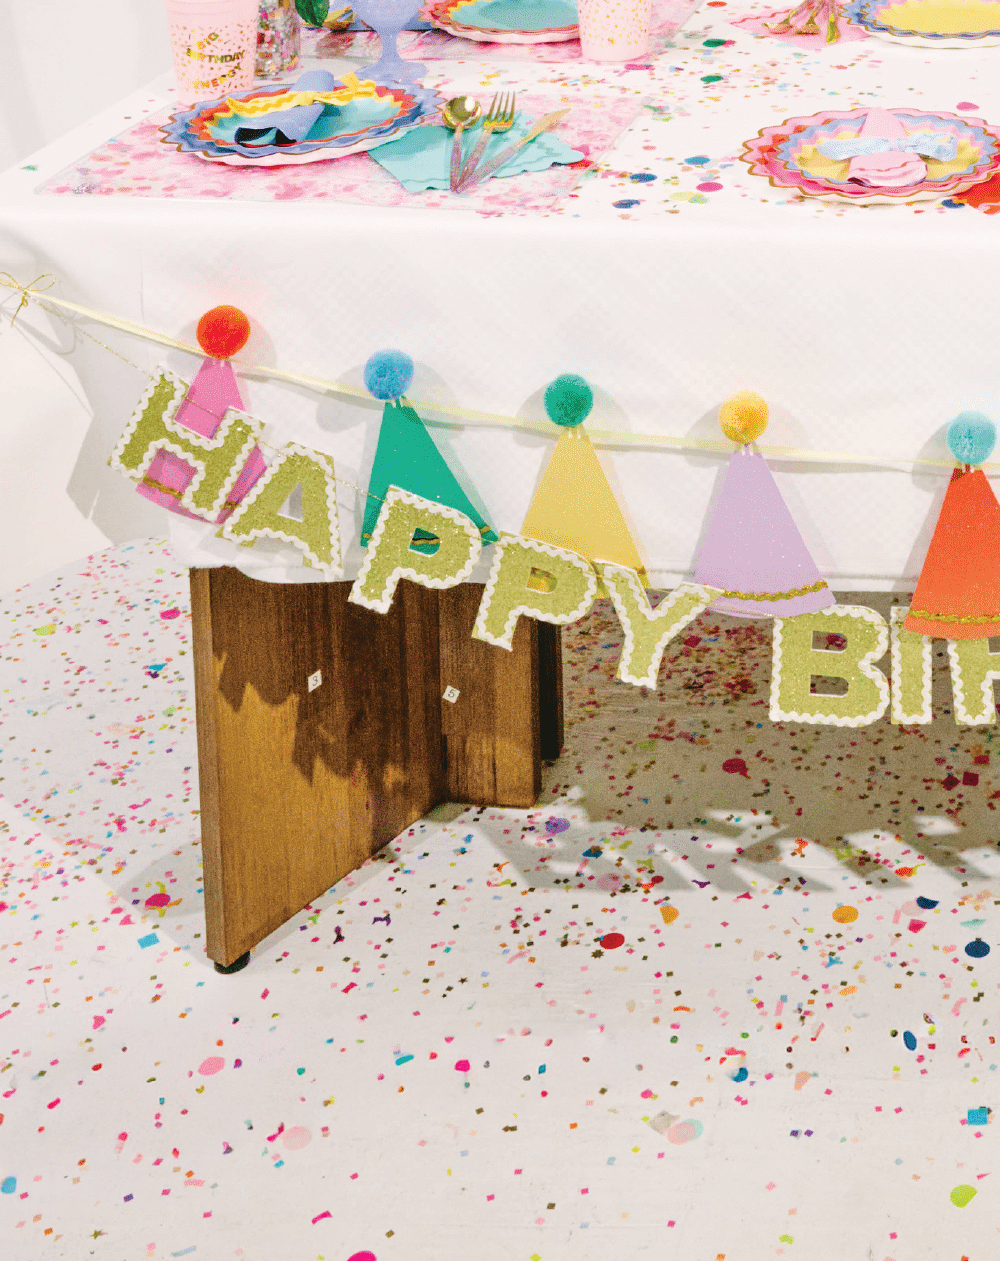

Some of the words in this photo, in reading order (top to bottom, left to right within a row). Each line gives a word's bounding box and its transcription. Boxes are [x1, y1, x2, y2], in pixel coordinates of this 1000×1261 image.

[195, 32, 220, 50] BIG
[186, 47, 246, 64] BIRTHDAY
[193, 62, 242, 90] ENERGY
[106, 362, 726, 691] HAPPY
